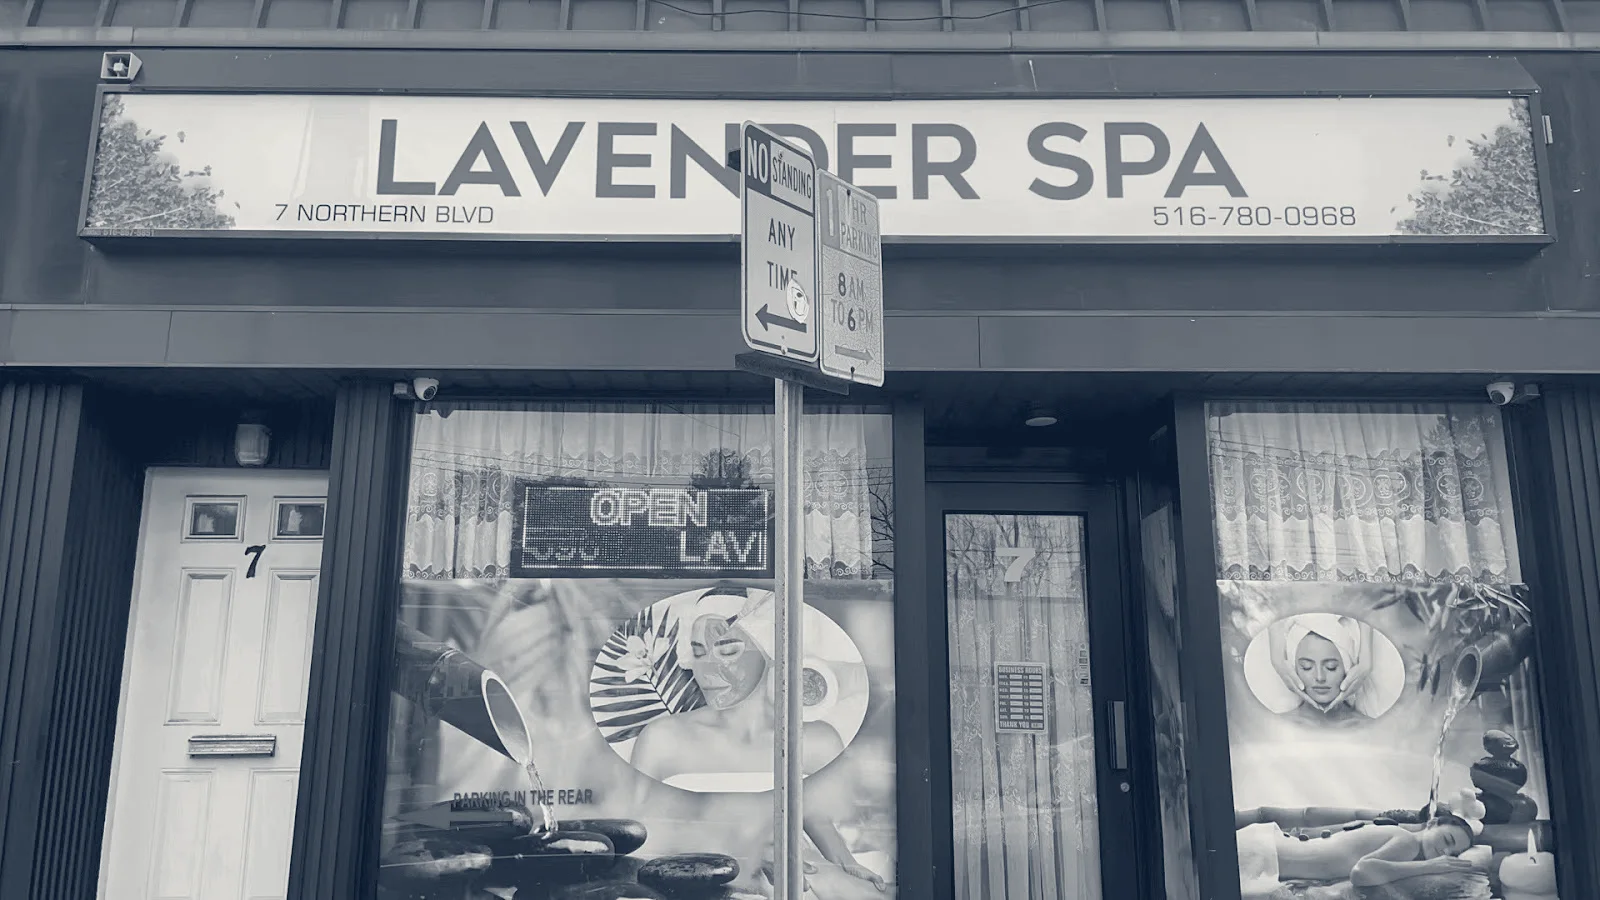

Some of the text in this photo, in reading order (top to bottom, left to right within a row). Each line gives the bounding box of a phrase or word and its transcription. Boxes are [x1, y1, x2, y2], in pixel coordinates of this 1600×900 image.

[747, 136, 812, 199] NO STANDING
[1026, 121, 1249, 201] SPA
[275, 203, 494, 224] 7 NORTHERN BLVD
[826, 188, 868, 237] 1 HR
[1153, 206, 1357, 226] 516-780-0968
[768, 218, 796, 251] ANY
[840, 222, 878, 259] PARKING
[830, 298, 845, 326] TO
[590, 489, 708, 527] OPEN
[244, 544, 267, 579] 7
[680, 530, 763, 563] LAV
[995, 547, 1036, 583] 7
[998, 666, 1025, 674] BUSINESS
[999, 720, 1019, 728] THANK
[1019, 720, 1030, 729] YOU
[453, 789, 594, 808] PARKING IN THE REAR
